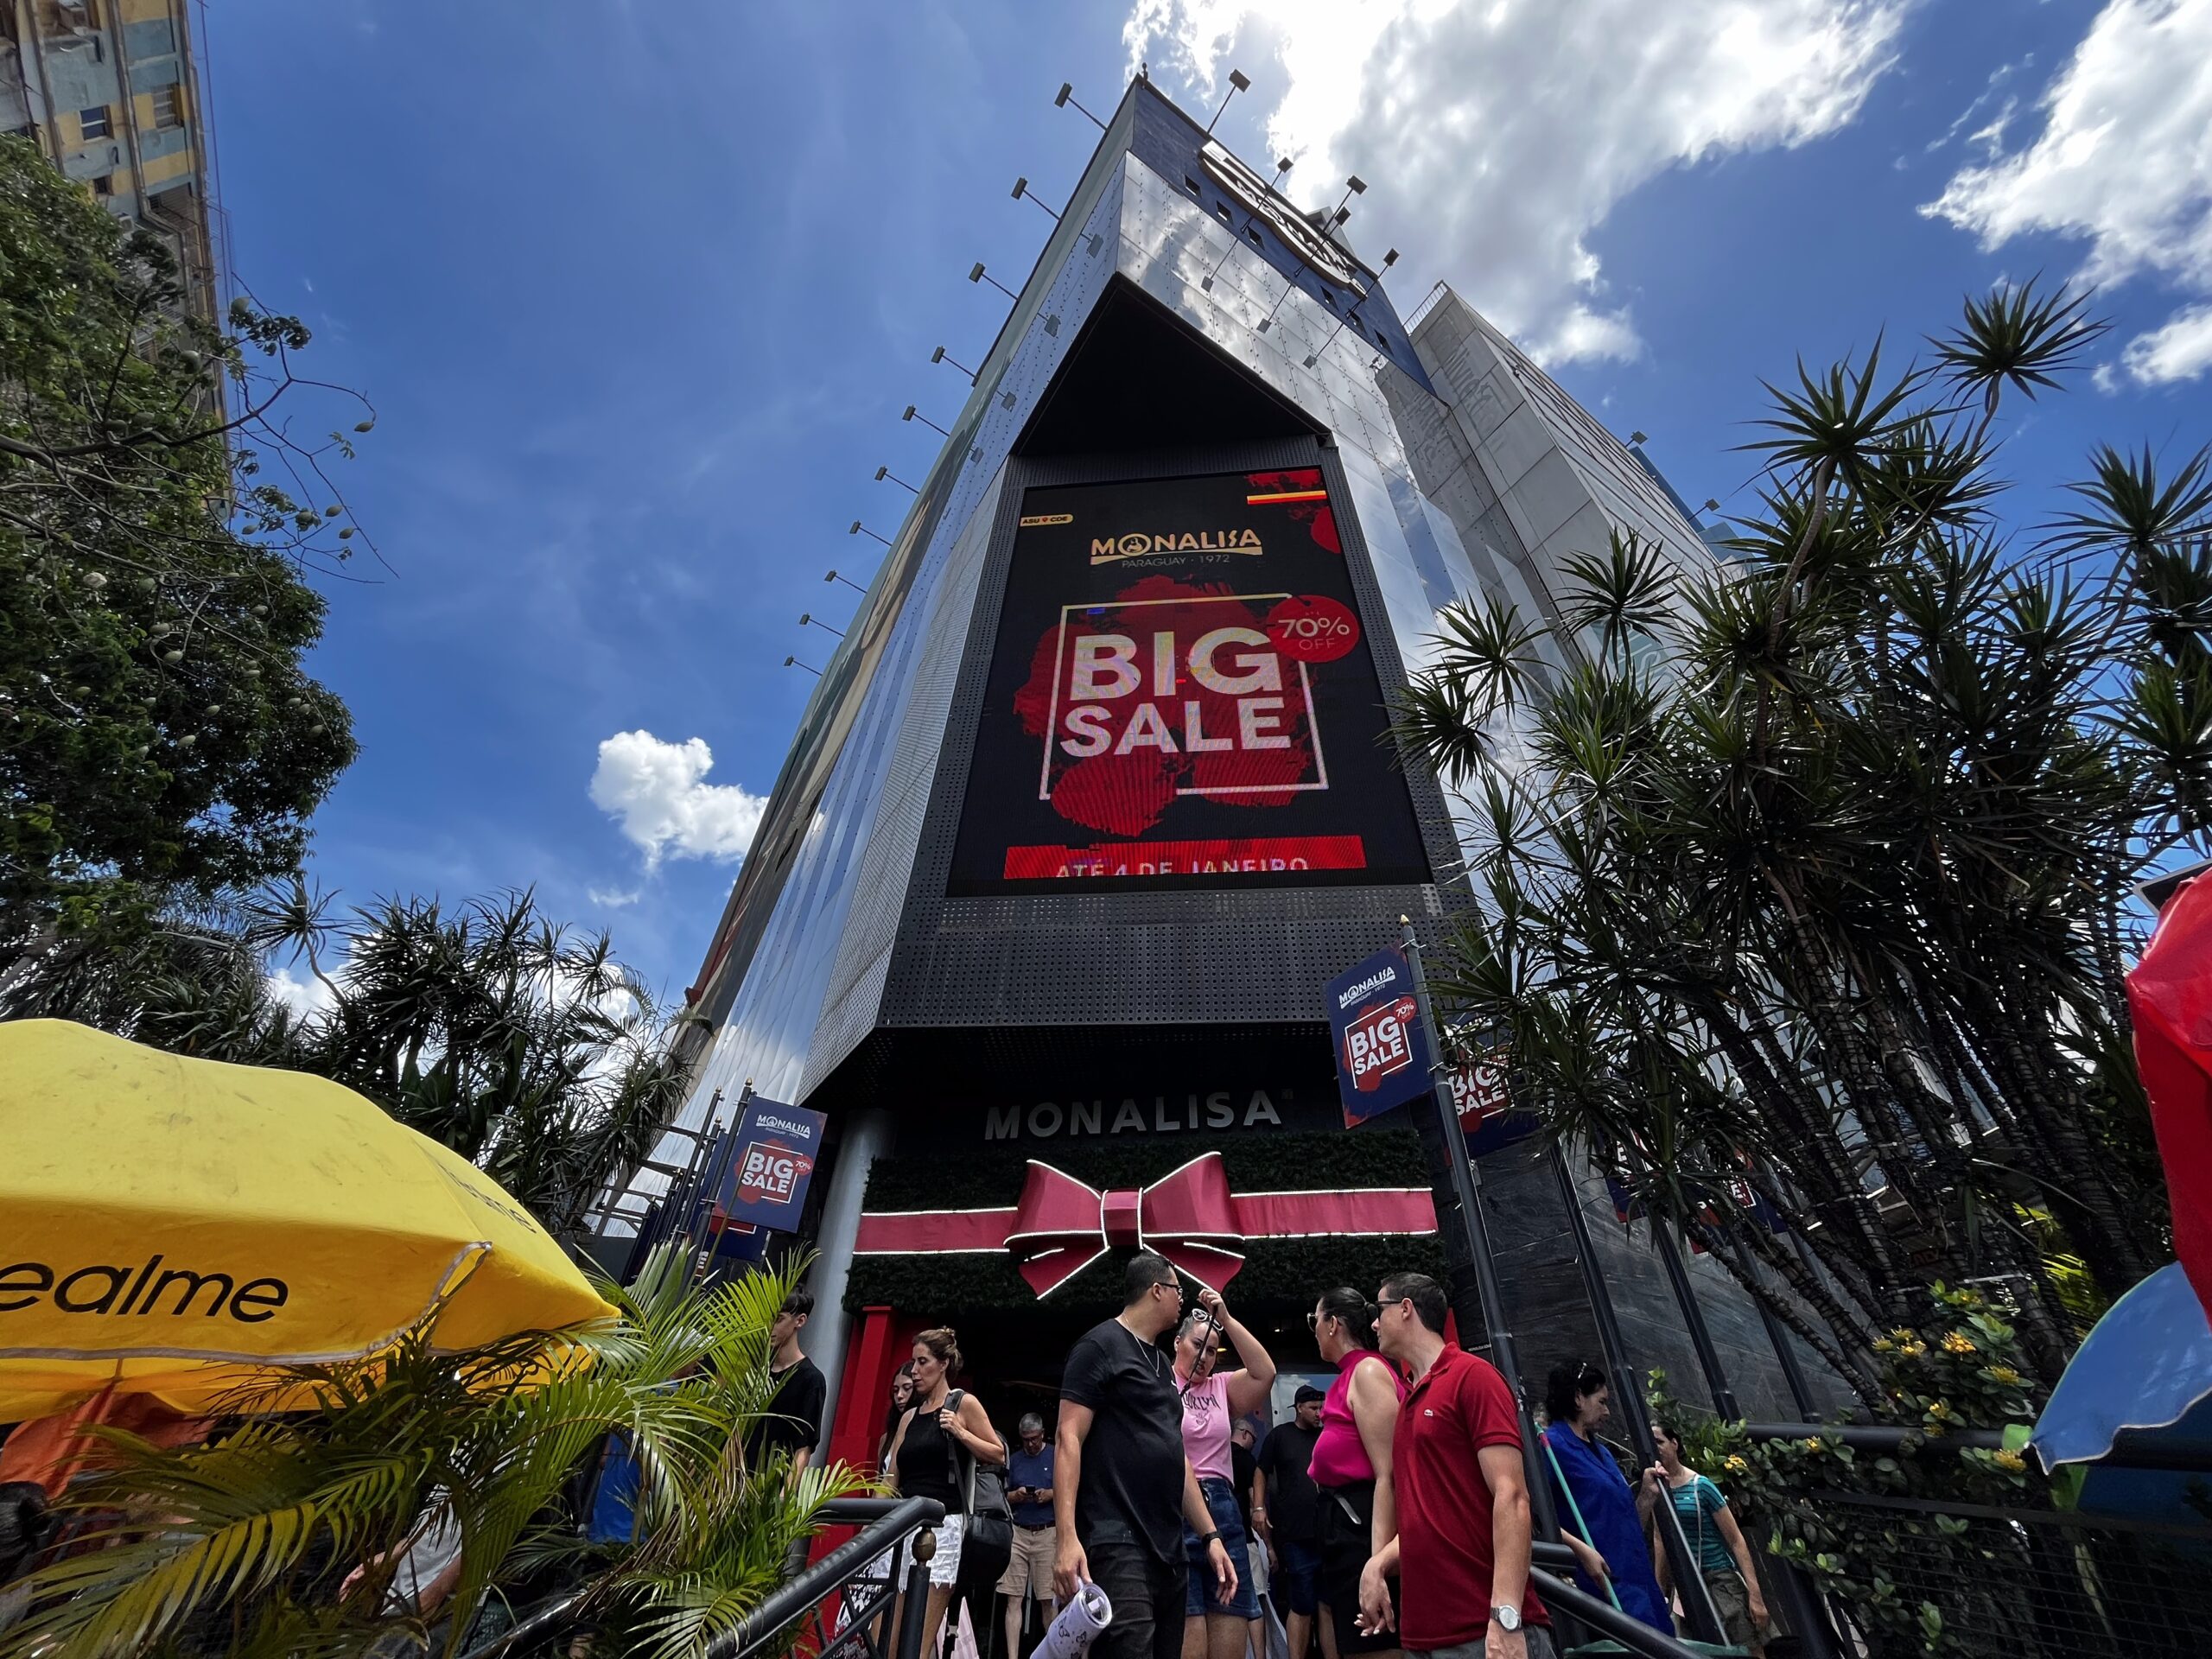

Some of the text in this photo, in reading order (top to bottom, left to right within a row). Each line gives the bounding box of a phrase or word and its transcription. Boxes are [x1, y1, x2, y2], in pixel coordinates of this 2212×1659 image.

[1090, 529, 1262, 556] MONALISA
[1122, 554, 1230, 568] PARAGUAY 1972
[1278, 616, 1350, 638] 70%
[1299, 638, 1335, 650] OFF
[1070, 626, 1283, 701] BIG
[1060, 696, 1291, 757] SALE
[1056, 858, 1104, 877] ATÉ
[1139, 861, 1173, 875] DE
[1338, 967, 1395, 1004] MONALISA
[1395, 1002, 1414, 1018] 70%
[1350, 1015, 1401, 1059] BIG
[1353, 1037, 1405, 1076] SALE
[1447, 1065, 1500, 1099] BIG
[1453, 1083, 1506, 1117] SALE
[757, 1114, 810, 1135] MONALISA
[984, 1090, 1281, 1141] MONALISA
[746, 1152, 794, 1180] BIG
[795, 1160, 810, 1170] 70%
[741, 1171, 790, 1194] SALE
